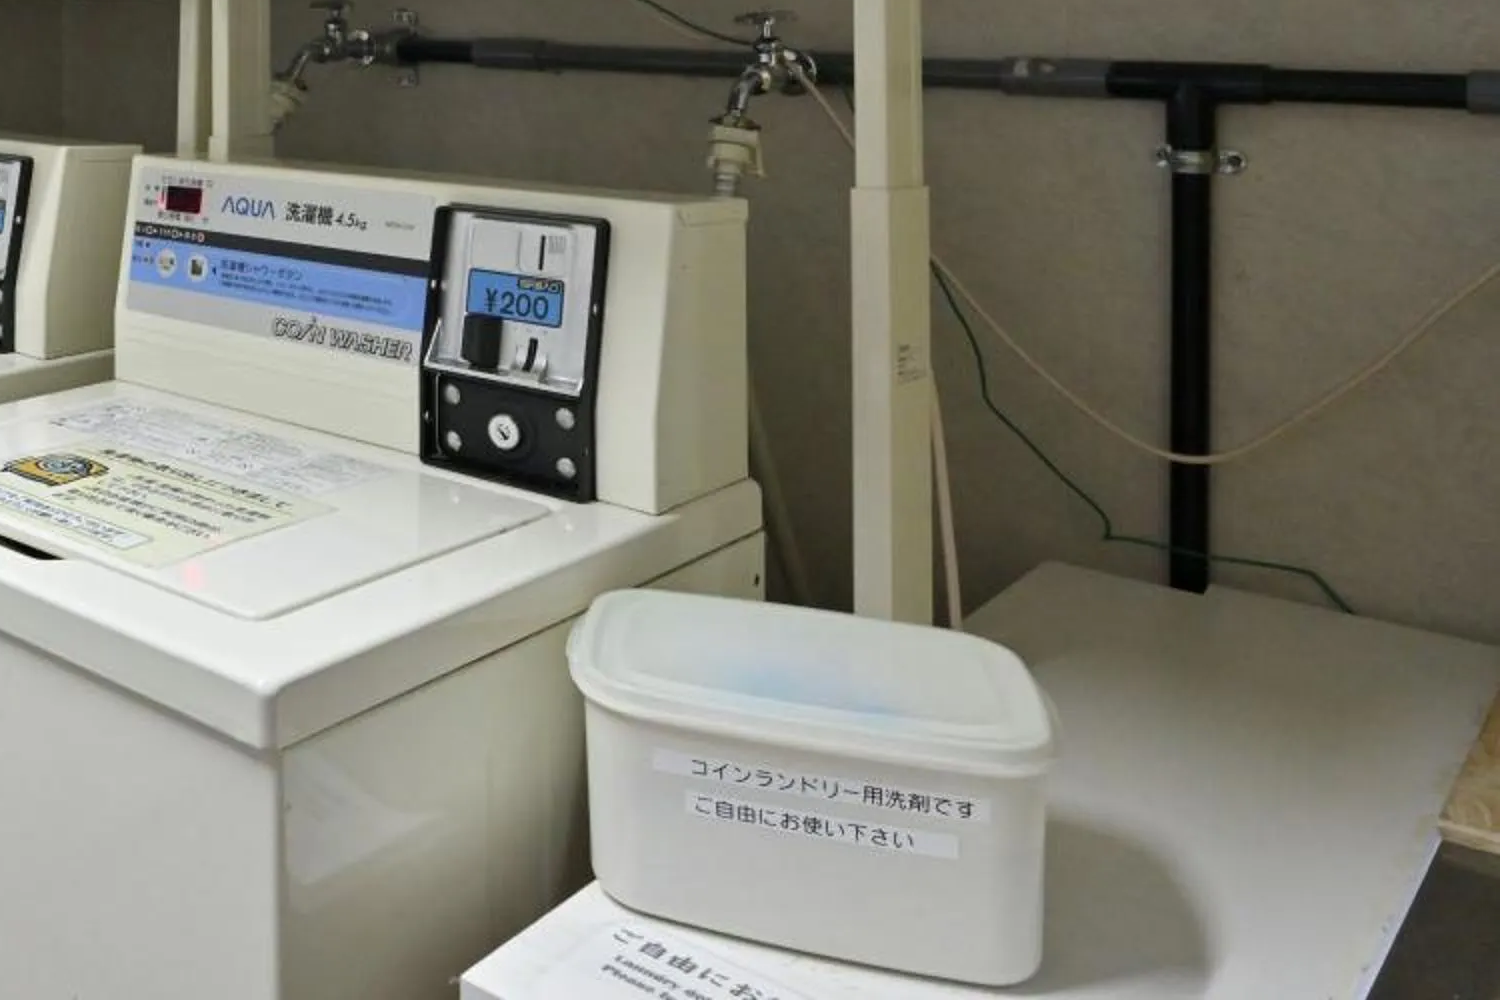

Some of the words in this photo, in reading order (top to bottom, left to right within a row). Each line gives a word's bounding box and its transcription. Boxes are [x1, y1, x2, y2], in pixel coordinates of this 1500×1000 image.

[221, 195, 275, 220] AQUA
[285, 201, 334, 227] 洗濯機
[484, 287, 549, 320] ¥200
[330, 327, 413, 362] WASHER
[691, 759, 975, 819] コインランドリー用洗剤です
[695, 796, 915, 849] ご自由にお使い下さい
[613, 929, 780, 1000] ご自由にお
